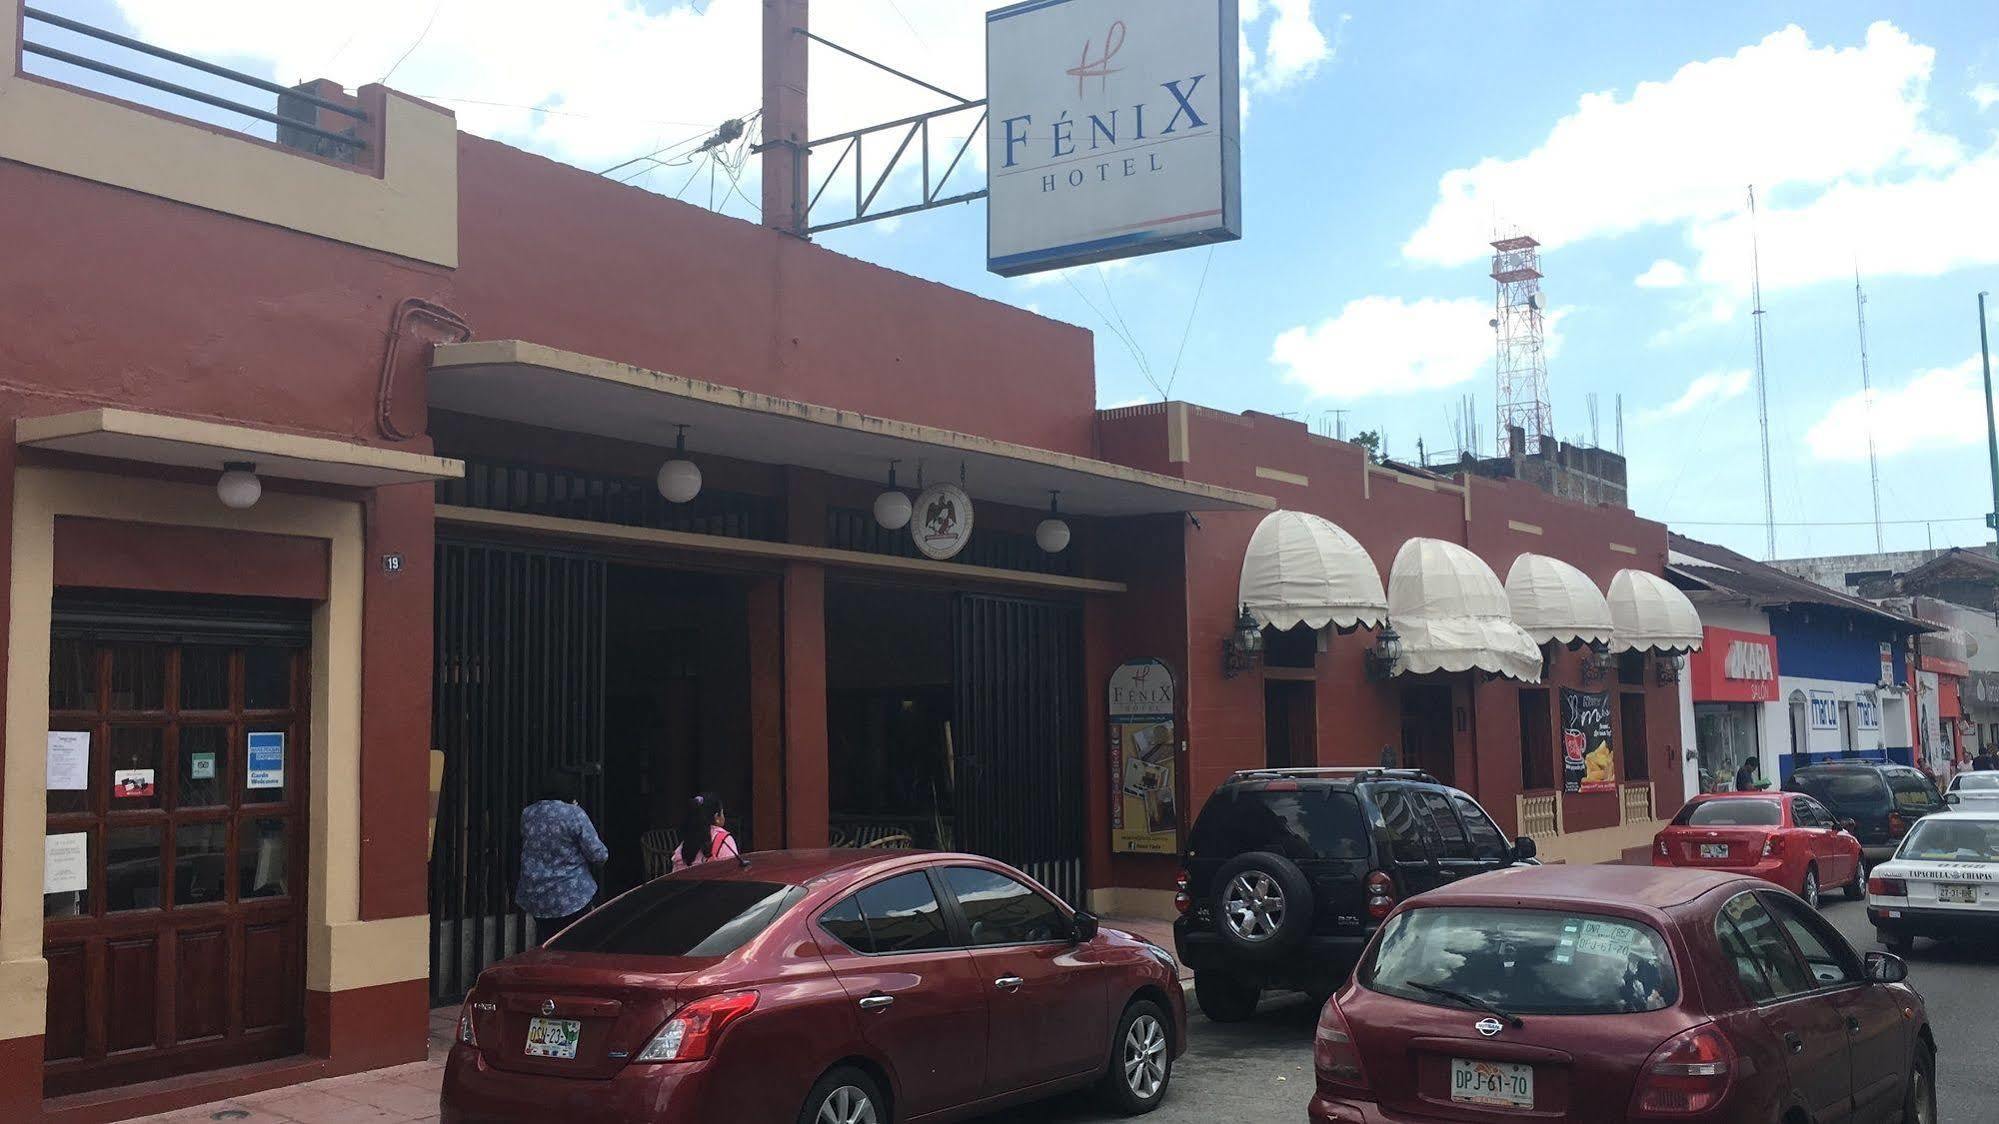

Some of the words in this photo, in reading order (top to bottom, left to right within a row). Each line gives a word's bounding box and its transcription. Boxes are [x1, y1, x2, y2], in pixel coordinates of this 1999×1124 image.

[1001, 74, 1208, 169] FÉNIX
[1042, 153, 1163, 193] HOTEL
[388, 557, 399, 569] 19
[1962, 871, 1993, 880] CHIAPAS
[1456, 1070, 1527, 1095] DPJ-61-70
